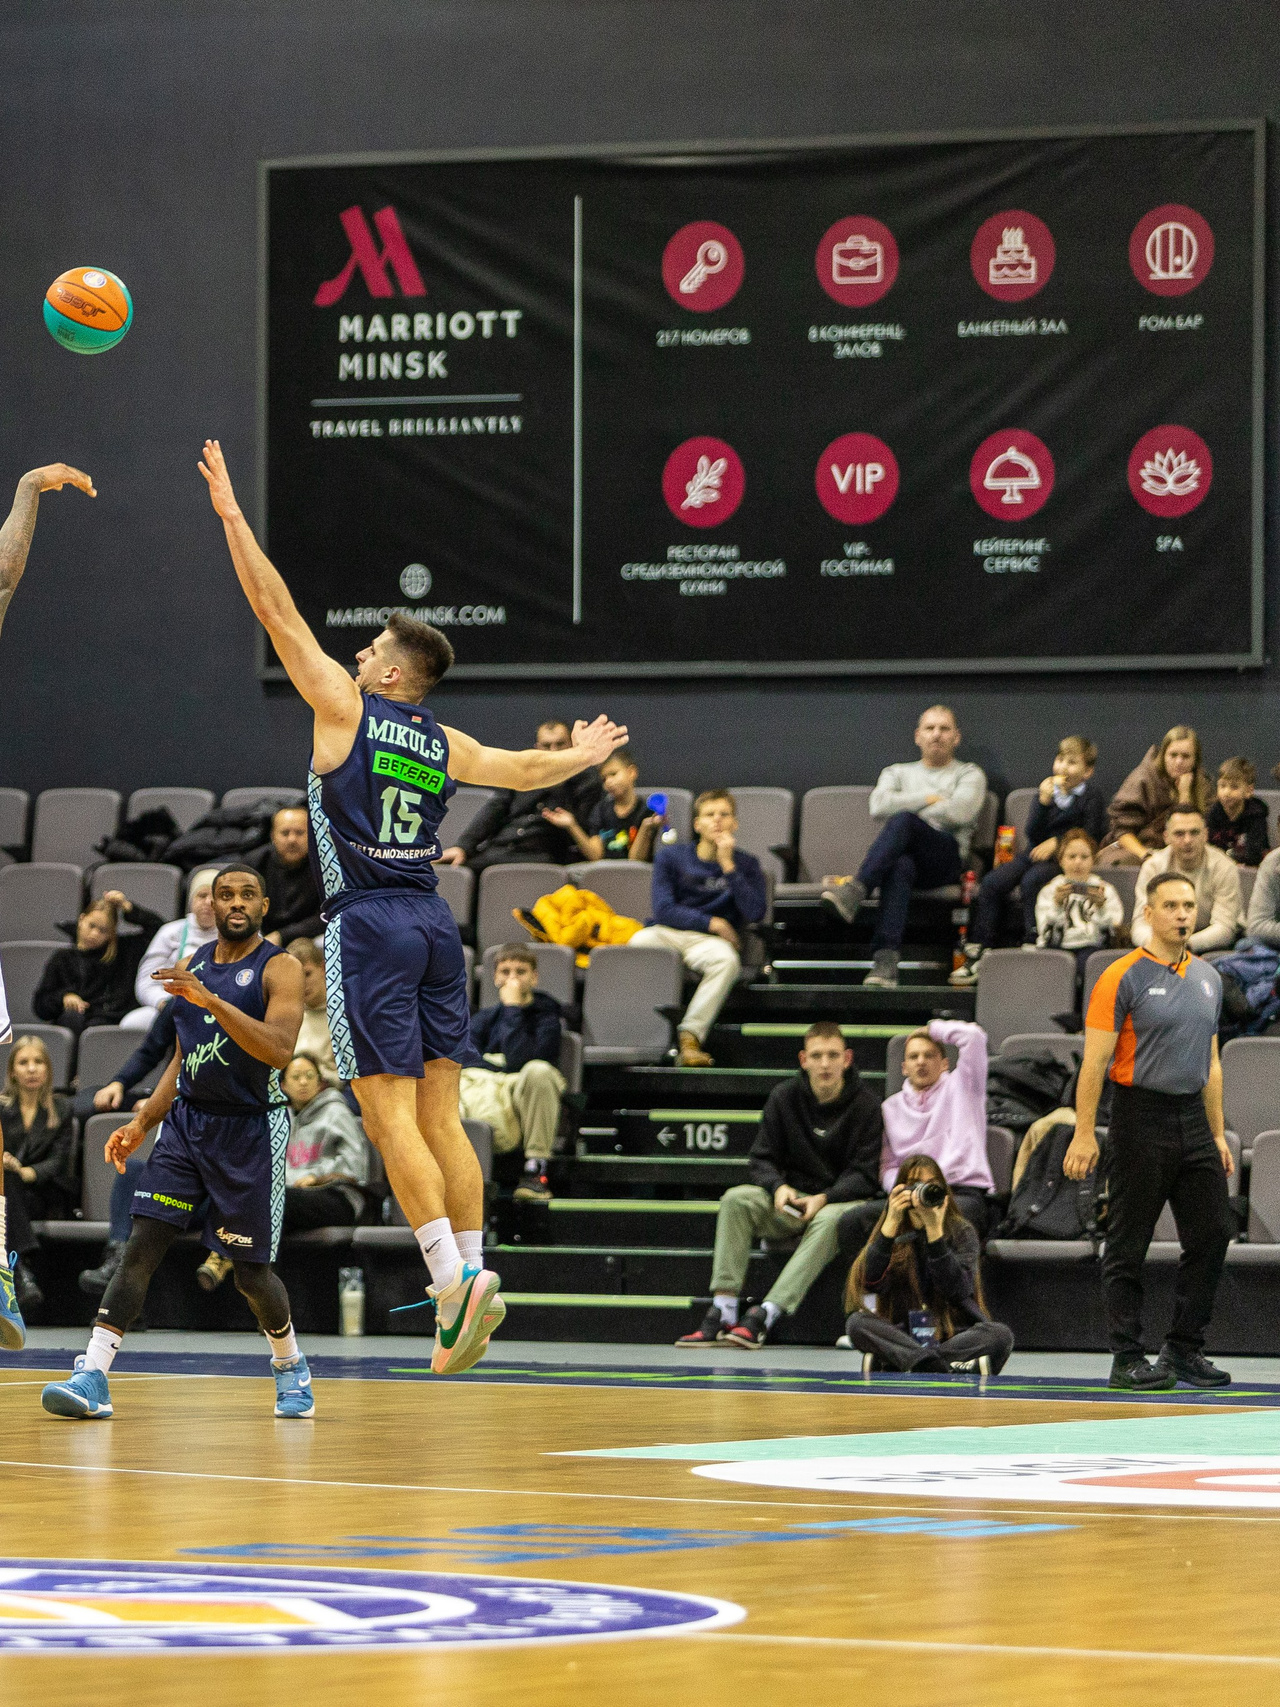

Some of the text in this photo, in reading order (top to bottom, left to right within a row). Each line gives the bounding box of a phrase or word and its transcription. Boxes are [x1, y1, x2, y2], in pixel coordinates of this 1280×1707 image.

[338, 309, 523, 343] MARRIOTT
[1039, 317, 1069, 336] ЗАЛ
[338, 350, 449, 382] MINSK
[310, 414, 522, 439] TRAVEL BRILLIANTLY
[830, 461, 886, 495] VIP
[1155, 534, 1184, 553] SPA
[378, 756, 442, 789] BETERA
[378, 785, 423, 844] 15
[682, 1122, 730, 1151] 105
